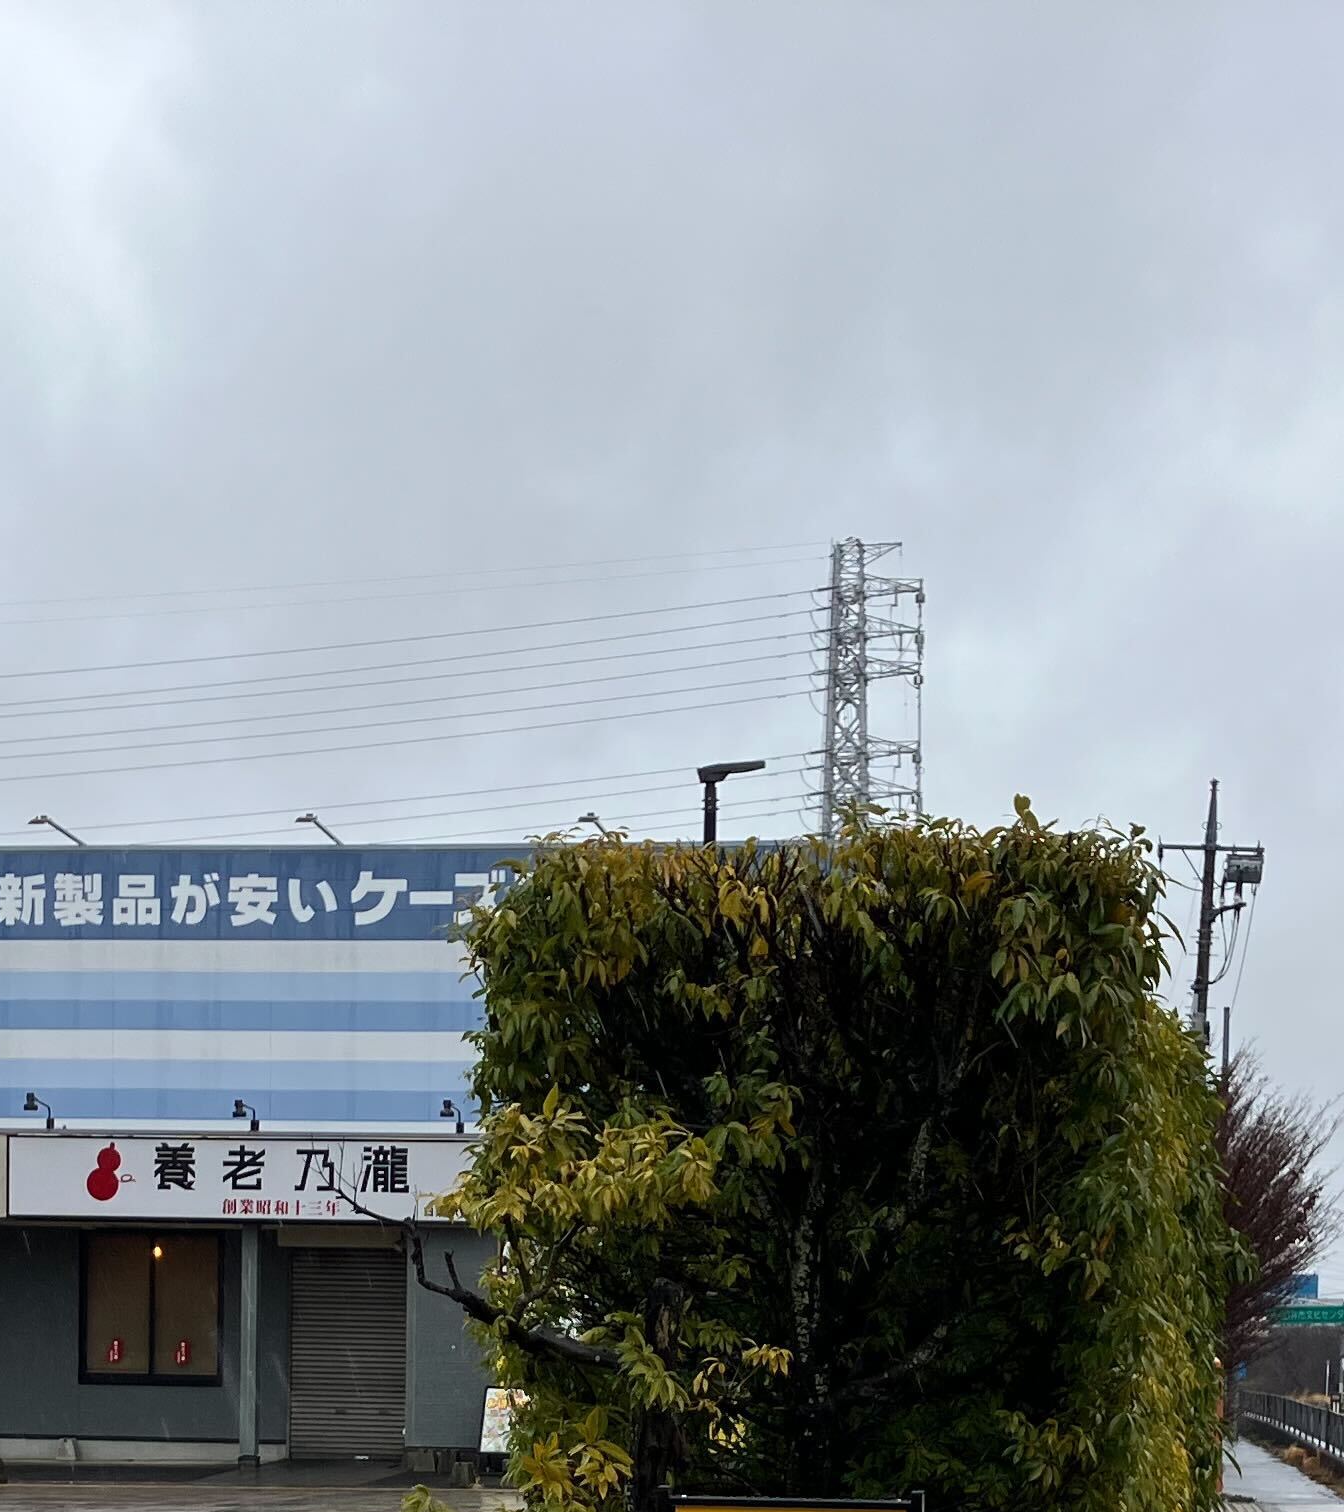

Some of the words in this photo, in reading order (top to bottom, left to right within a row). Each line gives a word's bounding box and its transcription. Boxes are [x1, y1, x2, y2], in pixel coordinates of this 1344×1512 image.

[153, 1142, 410, 1194] 養老乃瀧
[221, 1197, 341, 1217] 創業昭和十三年
